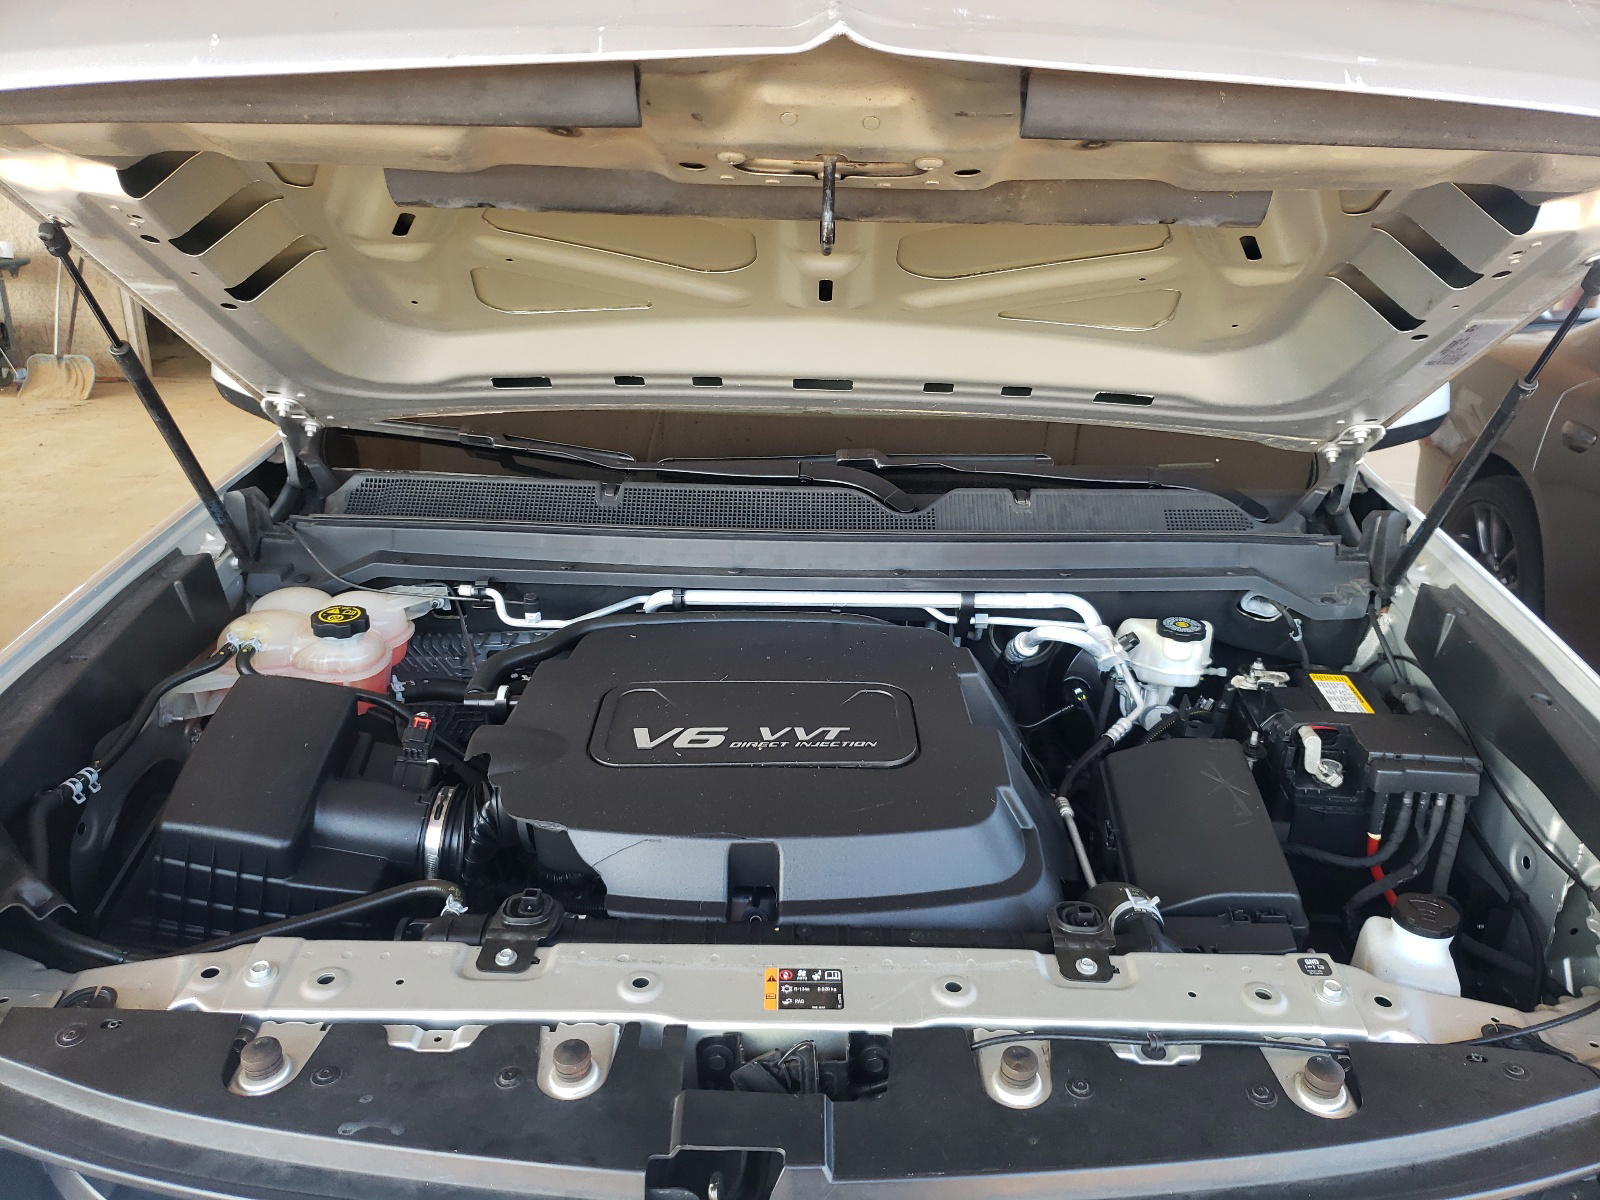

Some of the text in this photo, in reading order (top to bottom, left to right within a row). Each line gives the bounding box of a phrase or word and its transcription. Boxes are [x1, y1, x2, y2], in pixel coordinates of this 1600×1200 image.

[633, 727, 729, 750] V6
[759, 727, 851, 741] VVT
[729, 741, 878, 749] DIRECT INJECTION
